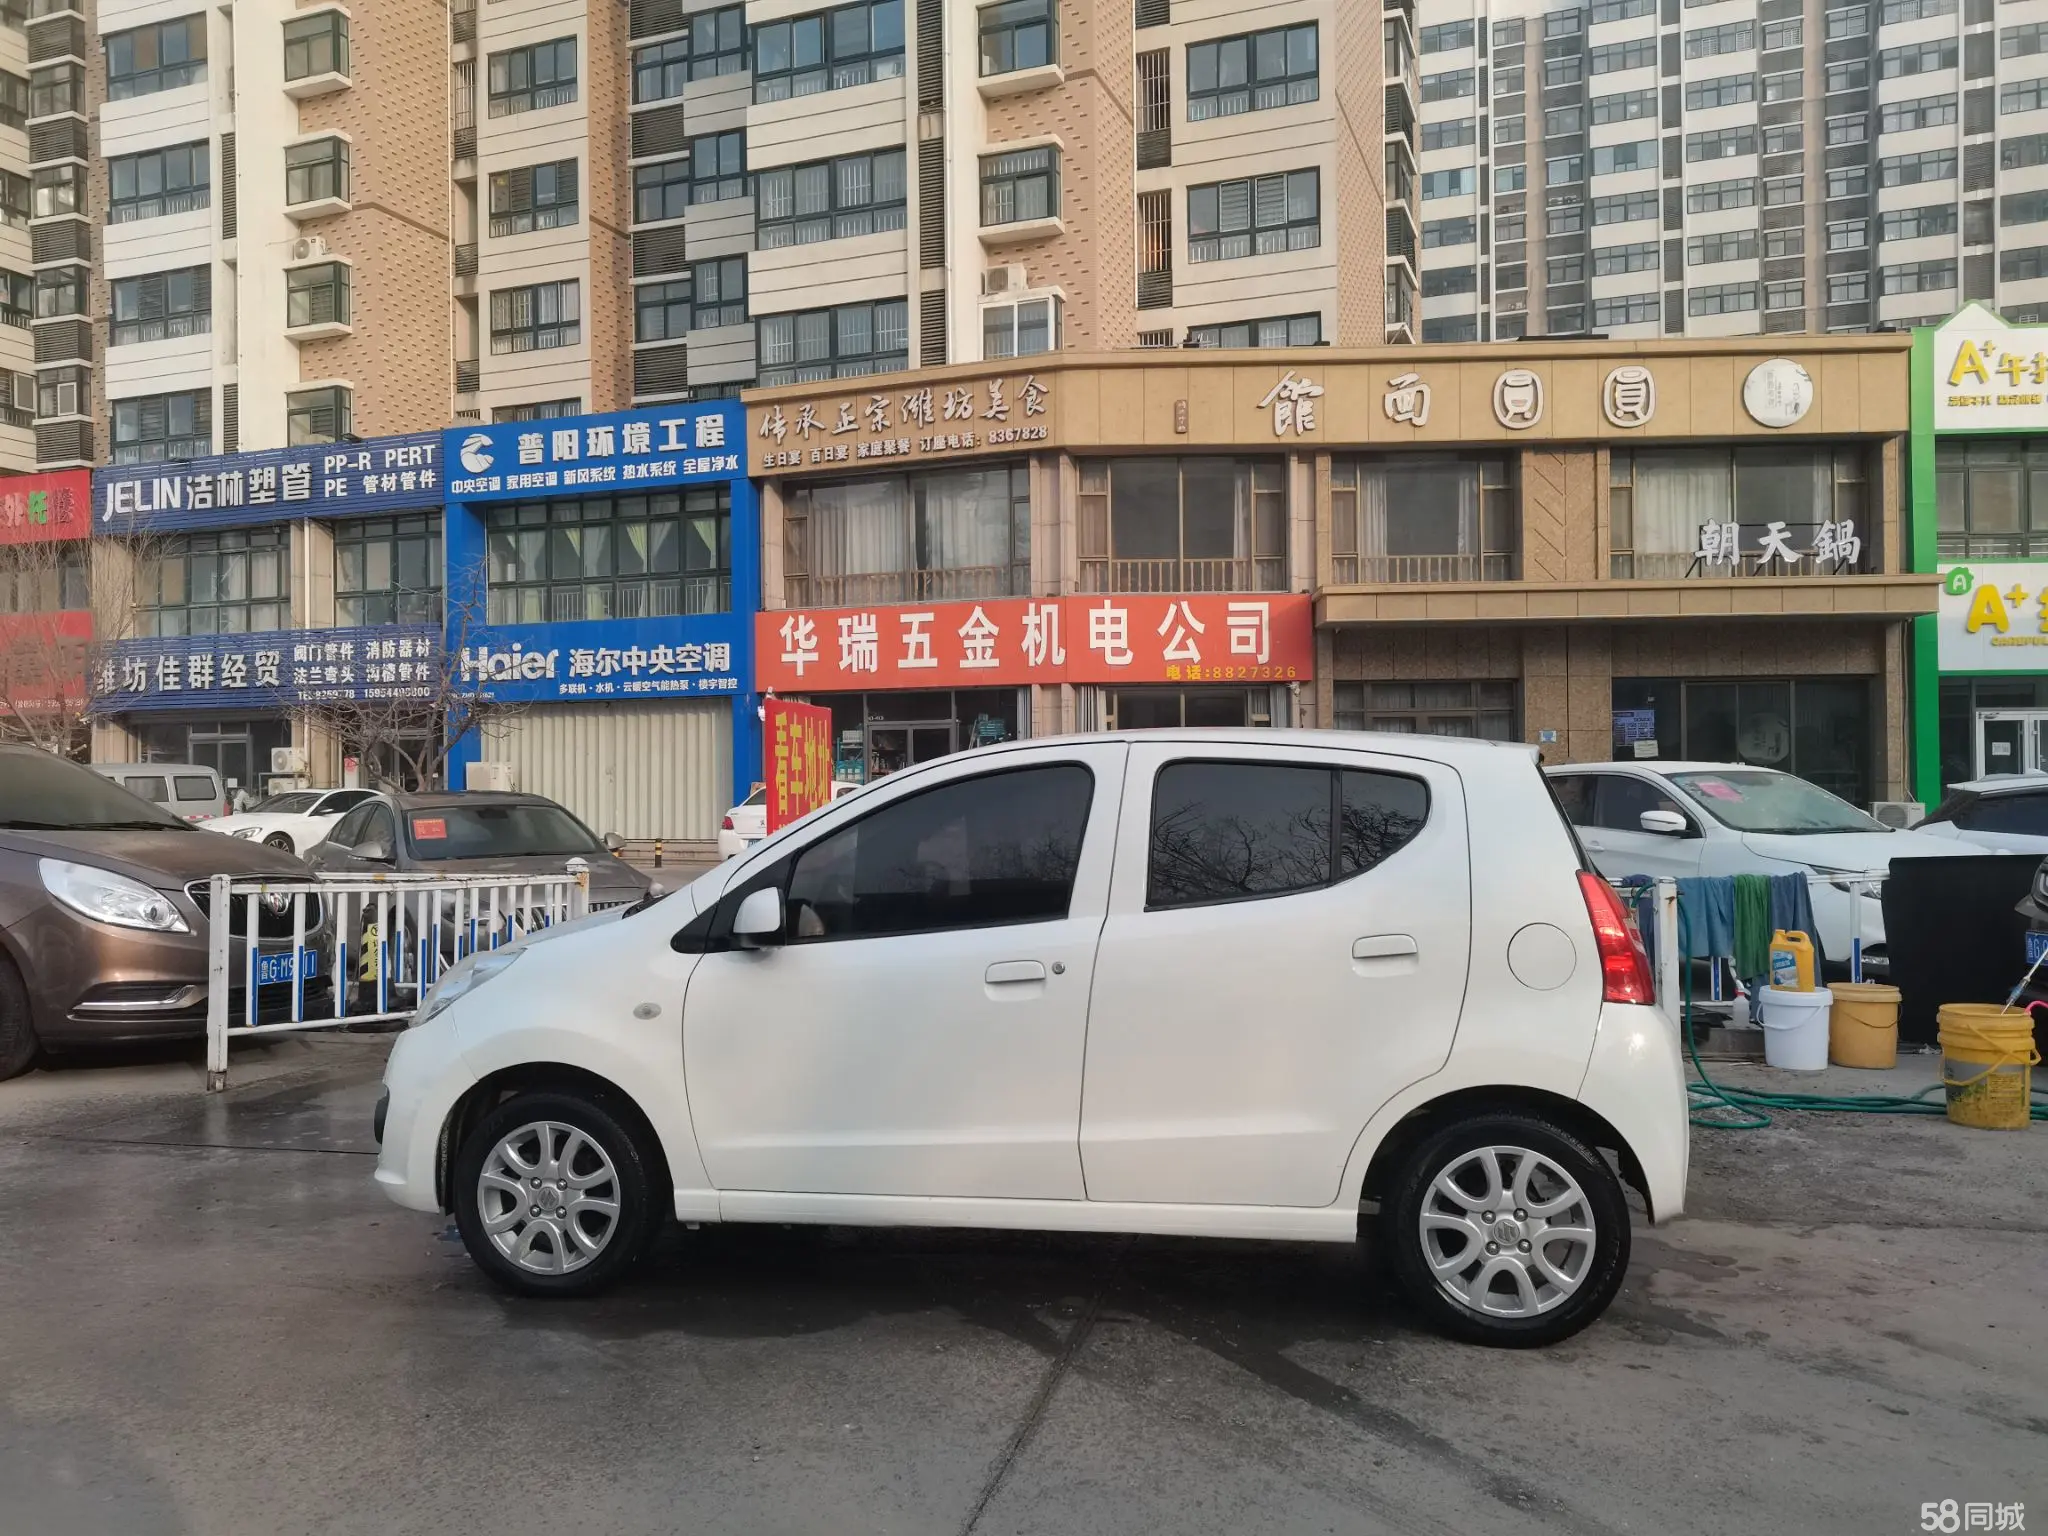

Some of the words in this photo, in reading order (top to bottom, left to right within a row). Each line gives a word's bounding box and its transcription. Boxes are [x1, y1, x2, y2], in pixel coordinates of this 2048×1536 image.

[324, 452, 371, 474] PP-R
[385, 444, 436, 468] PERT
[518, 414, 725, 465] 普阳环境工程
[763, 449, 801, 468] 生日宴
[810, 444, 849, 463] 百日宴
[857, 437, 911, 457] 家庭聚餐
[324, 477, 348, 498] PE
[363, 468, 437, 494] 管材管件
[451, 475, 501, 494] 中央空调
[506, 471, 558, 490] 家用空调
[563, 466, 617, 486] 新风系统
[622, 460, 677, 481] 热水系统
[683, 454, 739, 475] 全屋净水
[102, 476, 181, 522] JELIN
[365, 638, 431, 660] 消防器材
[779, 600, 1271, 677] 华瑞五金机电公司
[460, 642, 559, 682] Haier
[568, 642, 731, 678] 海尔中央空调
